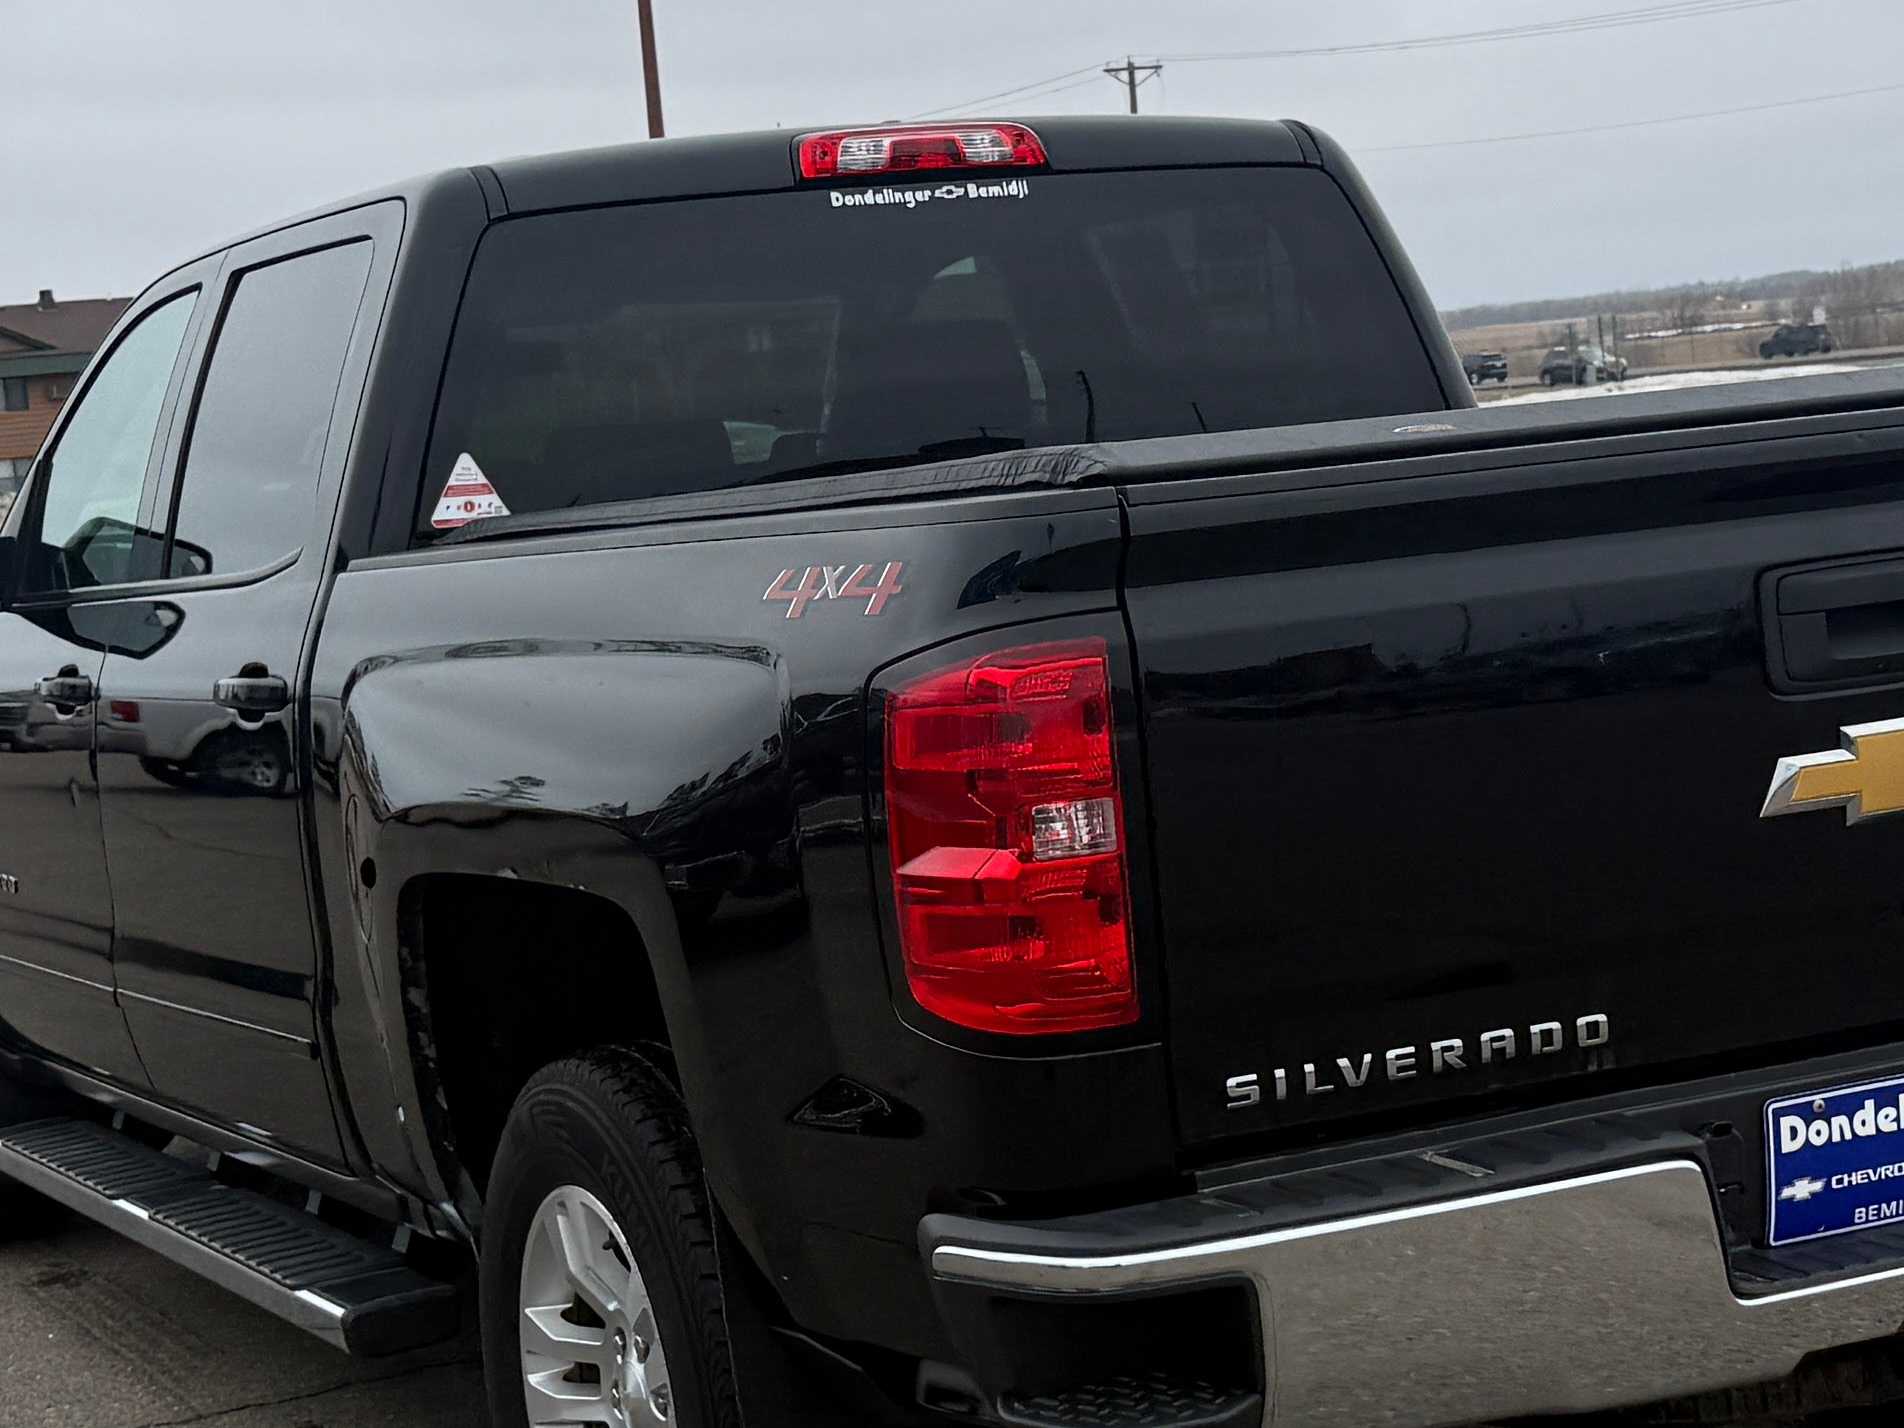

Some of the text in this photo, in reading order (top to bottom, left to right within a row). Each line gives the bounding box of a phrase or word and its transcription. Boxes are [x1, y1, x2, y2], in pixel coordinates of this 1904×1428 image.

[830, 179, 1029, 209] Dondelinger Bemidji
[1225, 1013, 1609, 1110] SILVERADO
